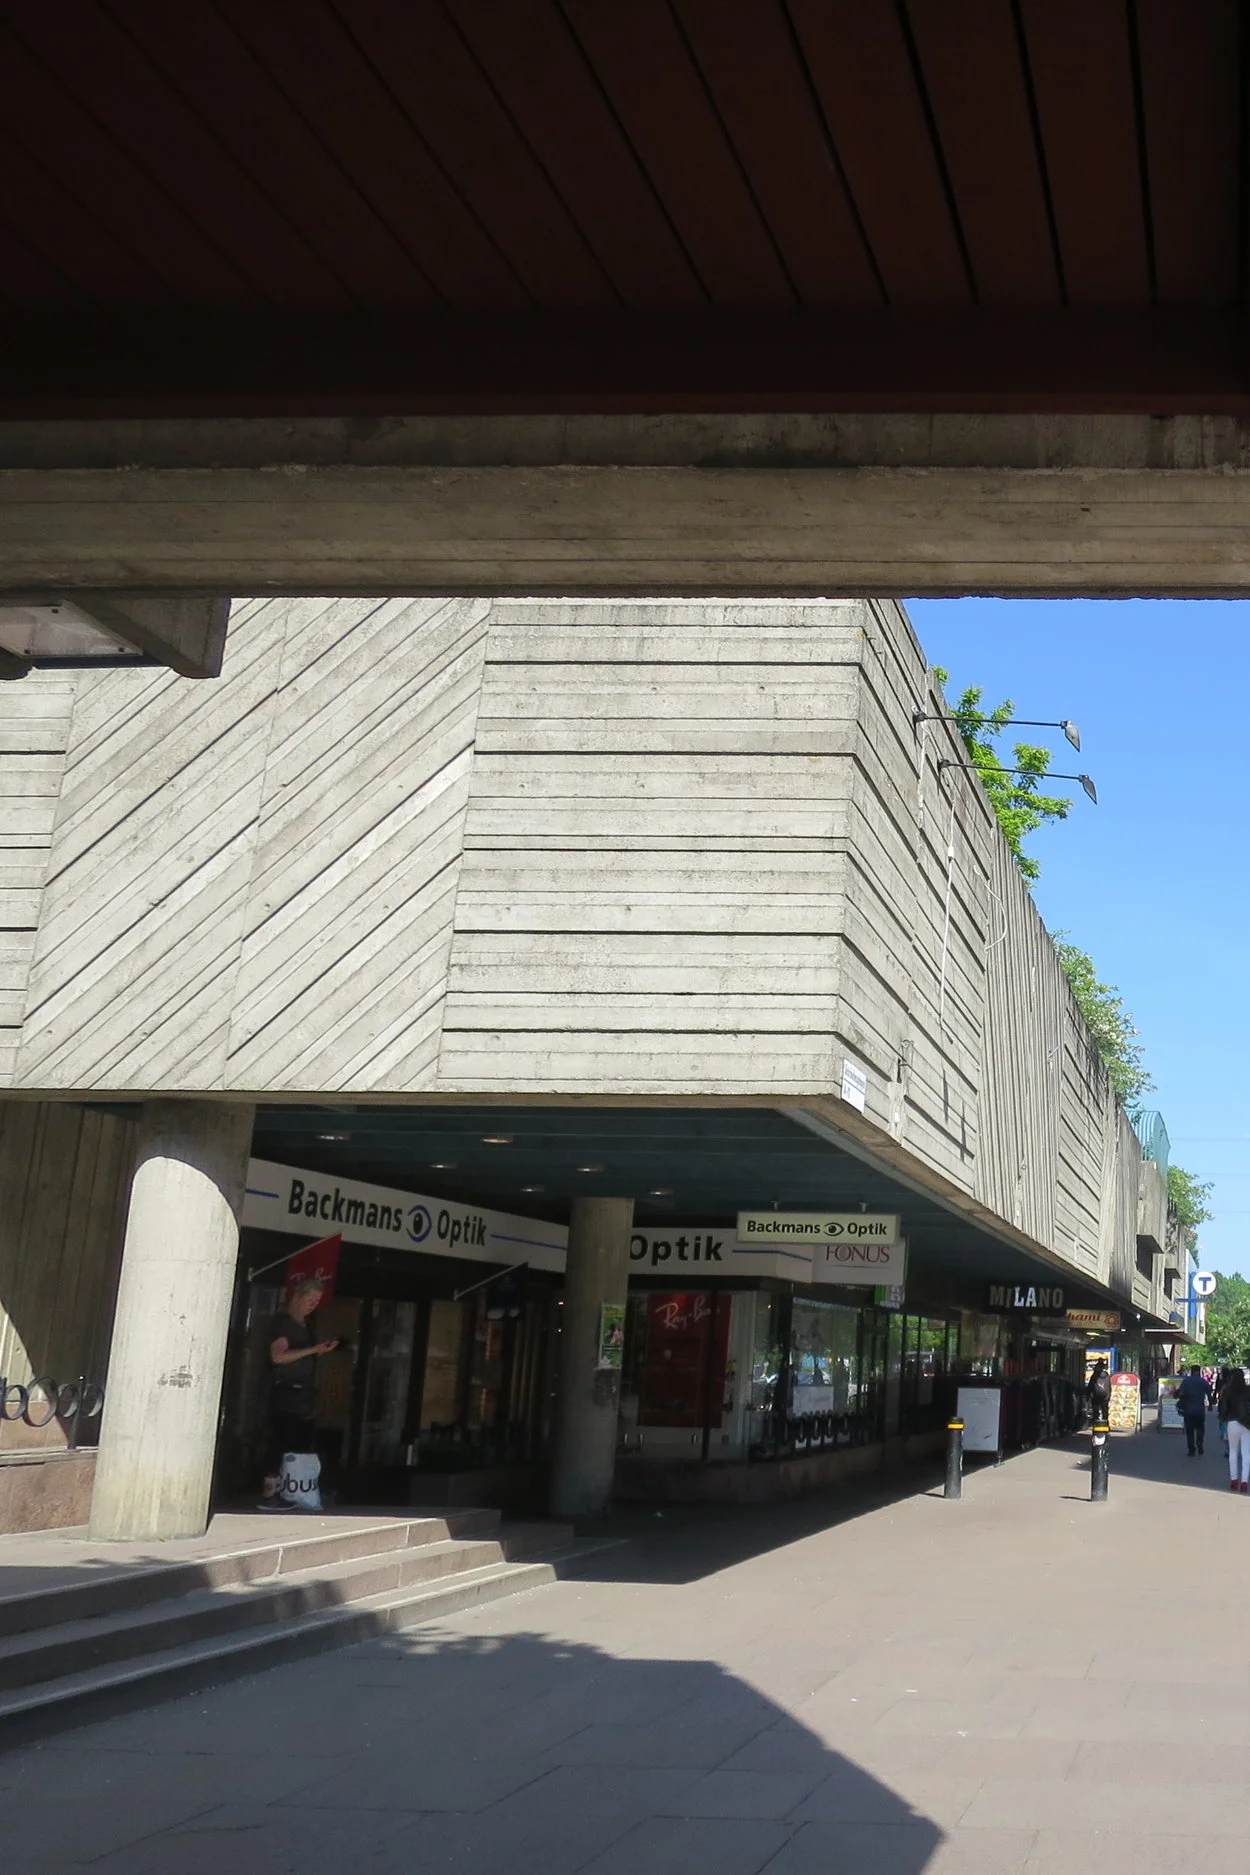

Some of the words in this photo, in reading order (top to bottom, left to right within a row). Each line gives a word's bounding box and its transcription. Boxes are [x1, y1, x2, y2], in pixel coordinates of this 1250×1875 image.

[288, 1179, 402, 1233] Backmans
[437, 1209, 487, 1248] Optik
[747, 1220, 821, 1234] Backmans
[847, 1222, 887, 1236] Optik
[630, 1235, 723, 1267] Optik
[826, 1245, 890, 1263] FONUS
[989, 1285, 1065, 1309] MILANO
